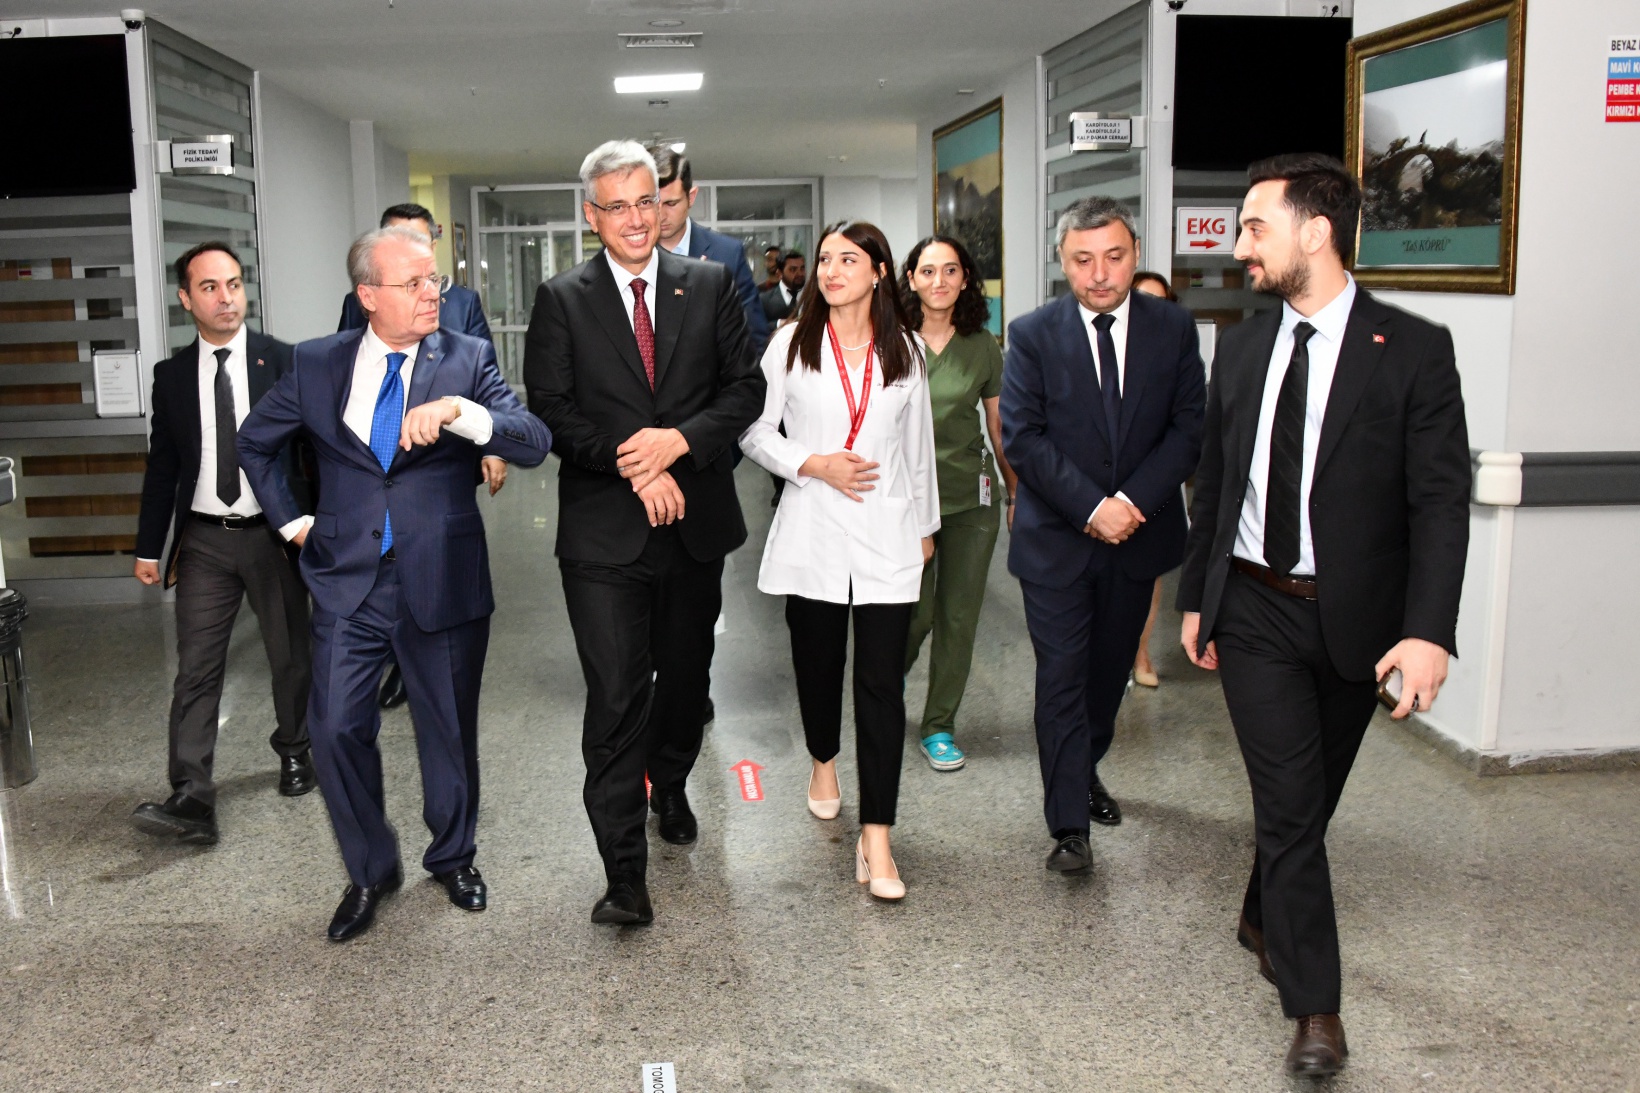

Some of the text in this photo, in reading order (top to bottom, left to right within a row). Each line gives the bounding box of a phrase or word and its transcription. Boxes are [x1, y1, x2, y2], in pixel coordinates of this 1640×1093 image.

[1611, 39, 1637, 51] BEYAZ
[1610, 59, 1632, 73] MAVİ
[1608, 83, 1635, 96] PEMBE
[1606, 105, 1636, 117] KIRMIZI
[1187, 217, 1226, 235] EKG
